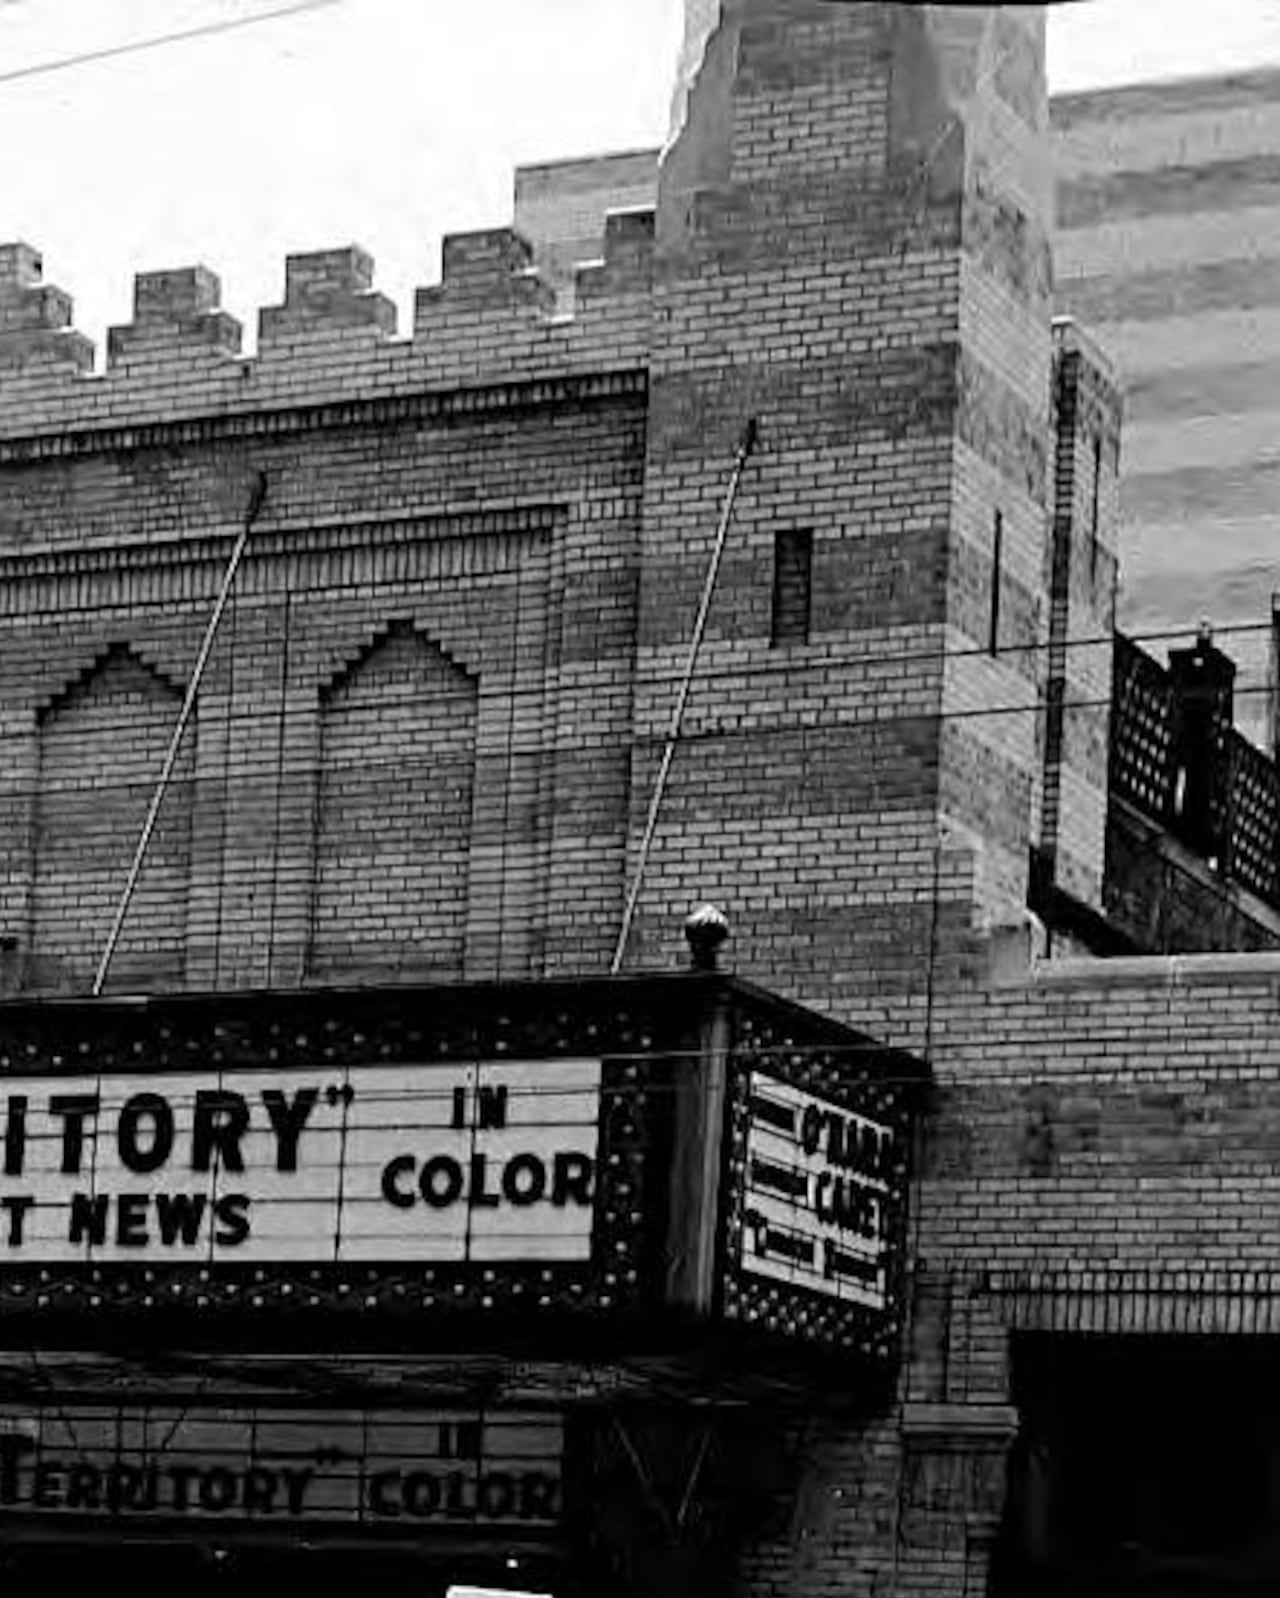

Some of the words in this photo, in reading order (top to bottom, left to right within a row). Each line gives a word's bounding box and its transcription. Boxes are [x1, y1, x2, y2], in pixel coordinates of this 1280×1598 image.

[452, 1085, 509, 1130] IN
[381, 1151, 594, 1208] COLOR
[68, 1192, 251, 1249] NEWS
